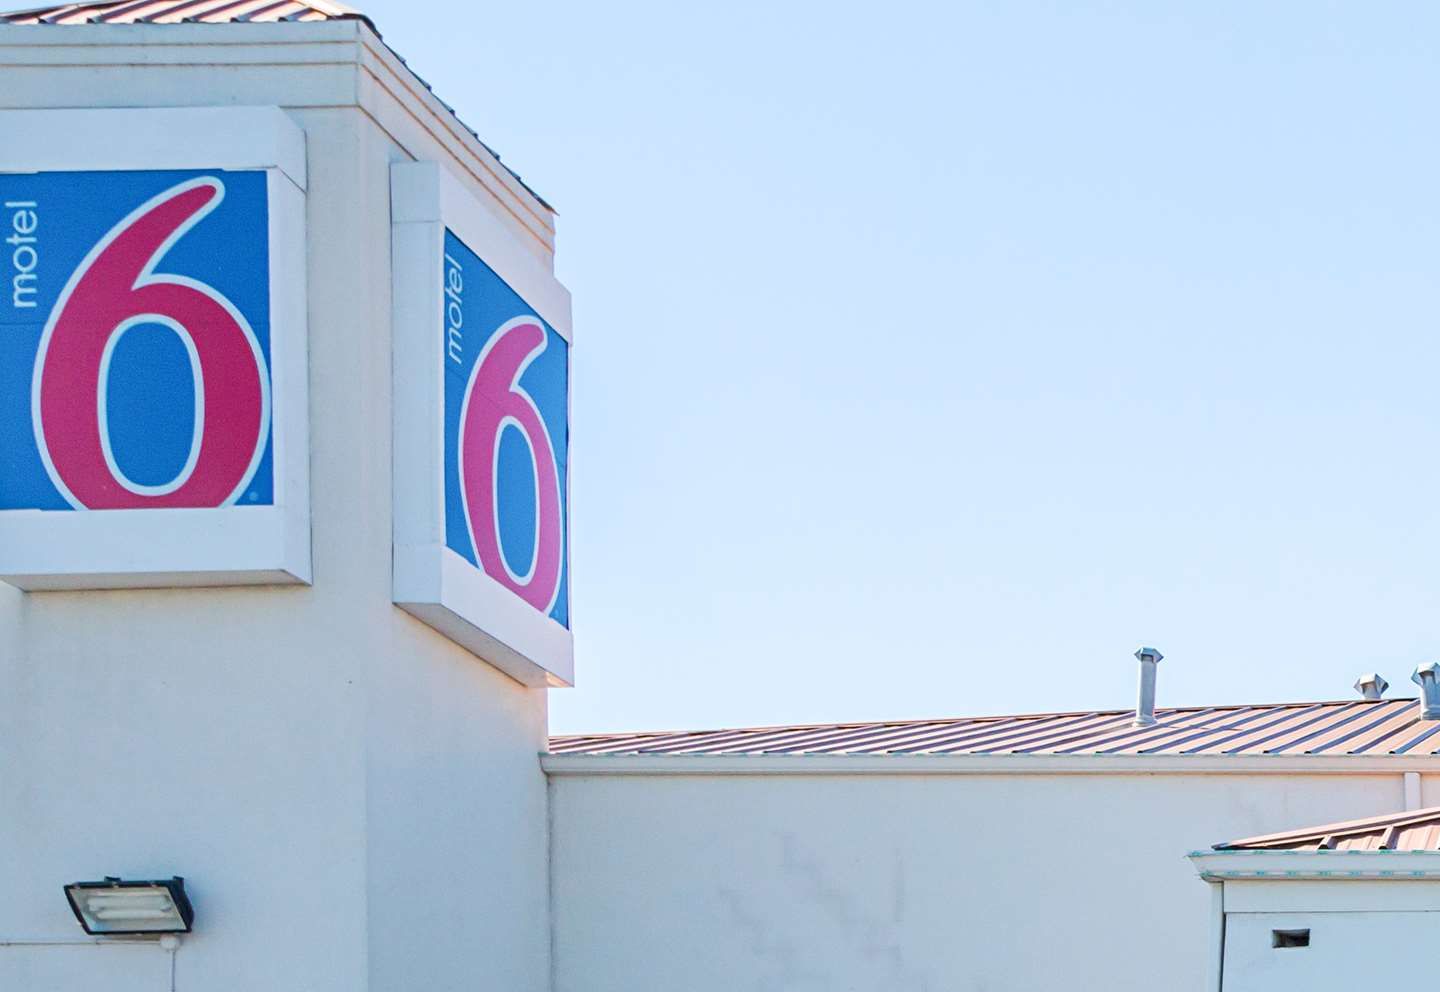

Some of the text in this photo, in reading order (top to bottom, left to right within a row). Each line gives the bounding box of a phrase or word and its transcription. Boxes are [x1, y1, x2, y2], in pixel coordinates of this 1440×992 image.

[6, 175, 271, 510] motel 6
[443, 254, 564, 616] motel 6
